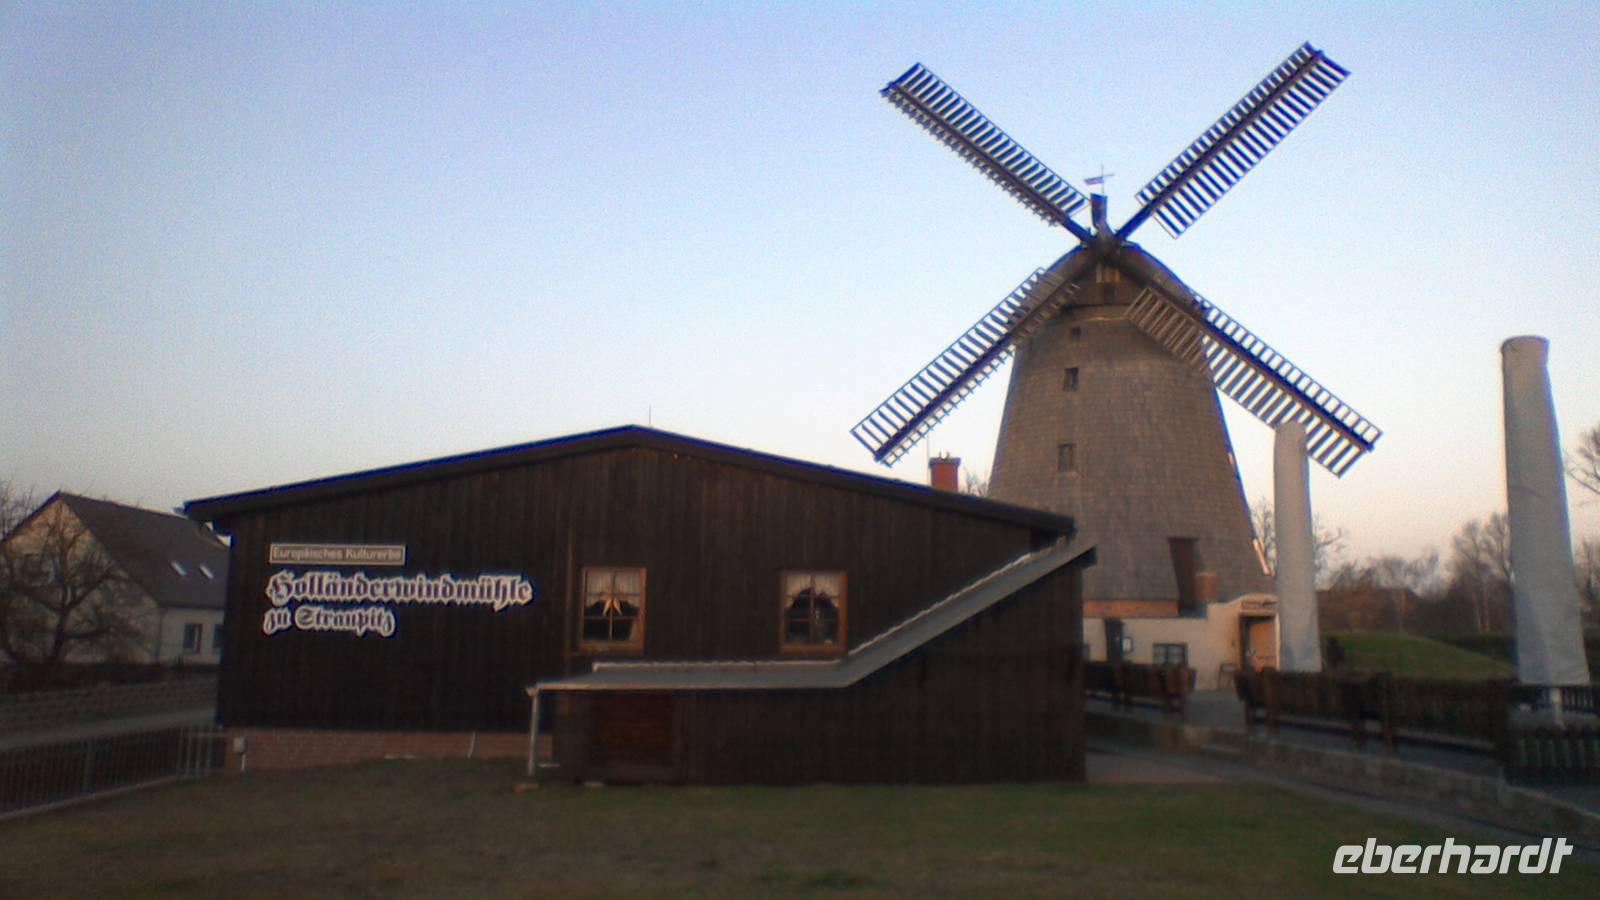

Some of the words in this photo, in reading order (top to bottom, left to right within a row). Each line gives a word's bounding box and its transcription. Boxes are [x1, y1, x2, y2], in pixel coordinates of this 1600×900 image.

[266, 571, 532, 610] Holländerwindmühle
[264, 607, 291, 634] zu
[295, 605, 395, 636] Straupitz
